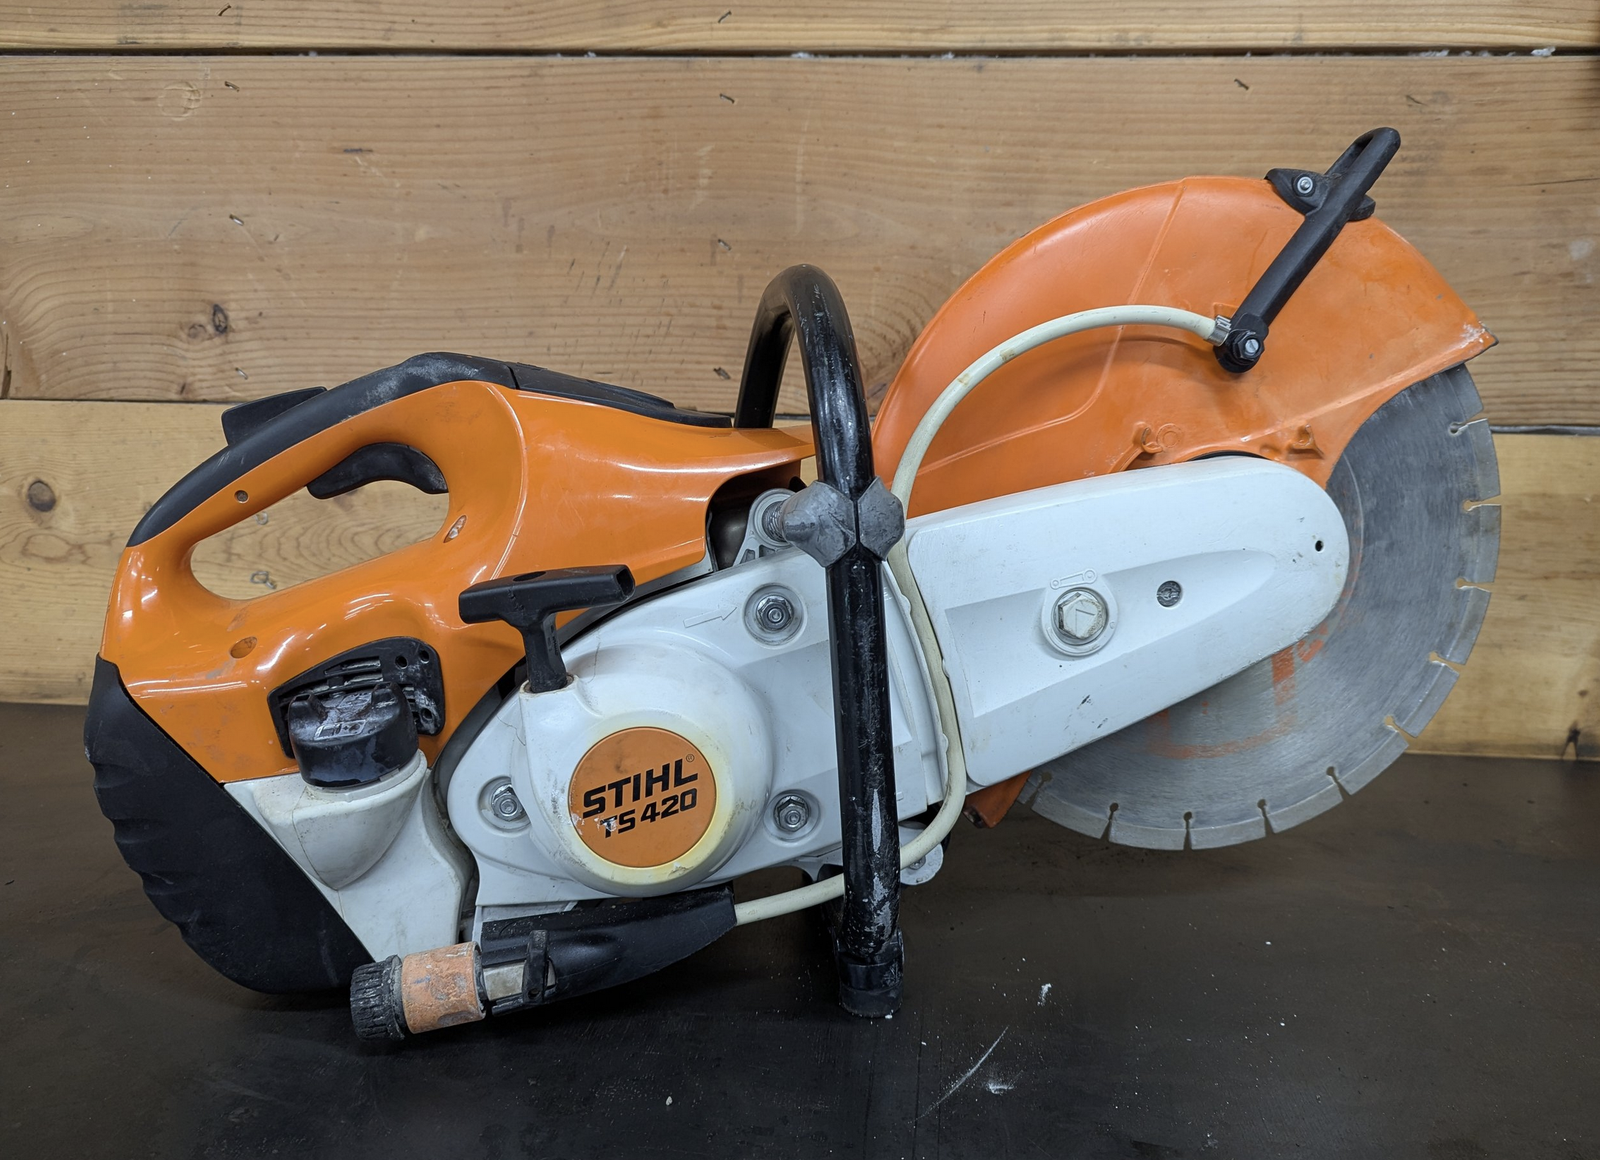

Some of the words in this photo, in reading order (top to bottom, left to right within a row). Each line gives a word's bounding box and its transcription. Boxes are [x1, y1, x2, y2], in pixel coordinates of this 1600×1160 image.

[582, 758, 698, 819] STIHL
[600, 808, 636, 838] TS
[640, 788, 698, 823] 420
